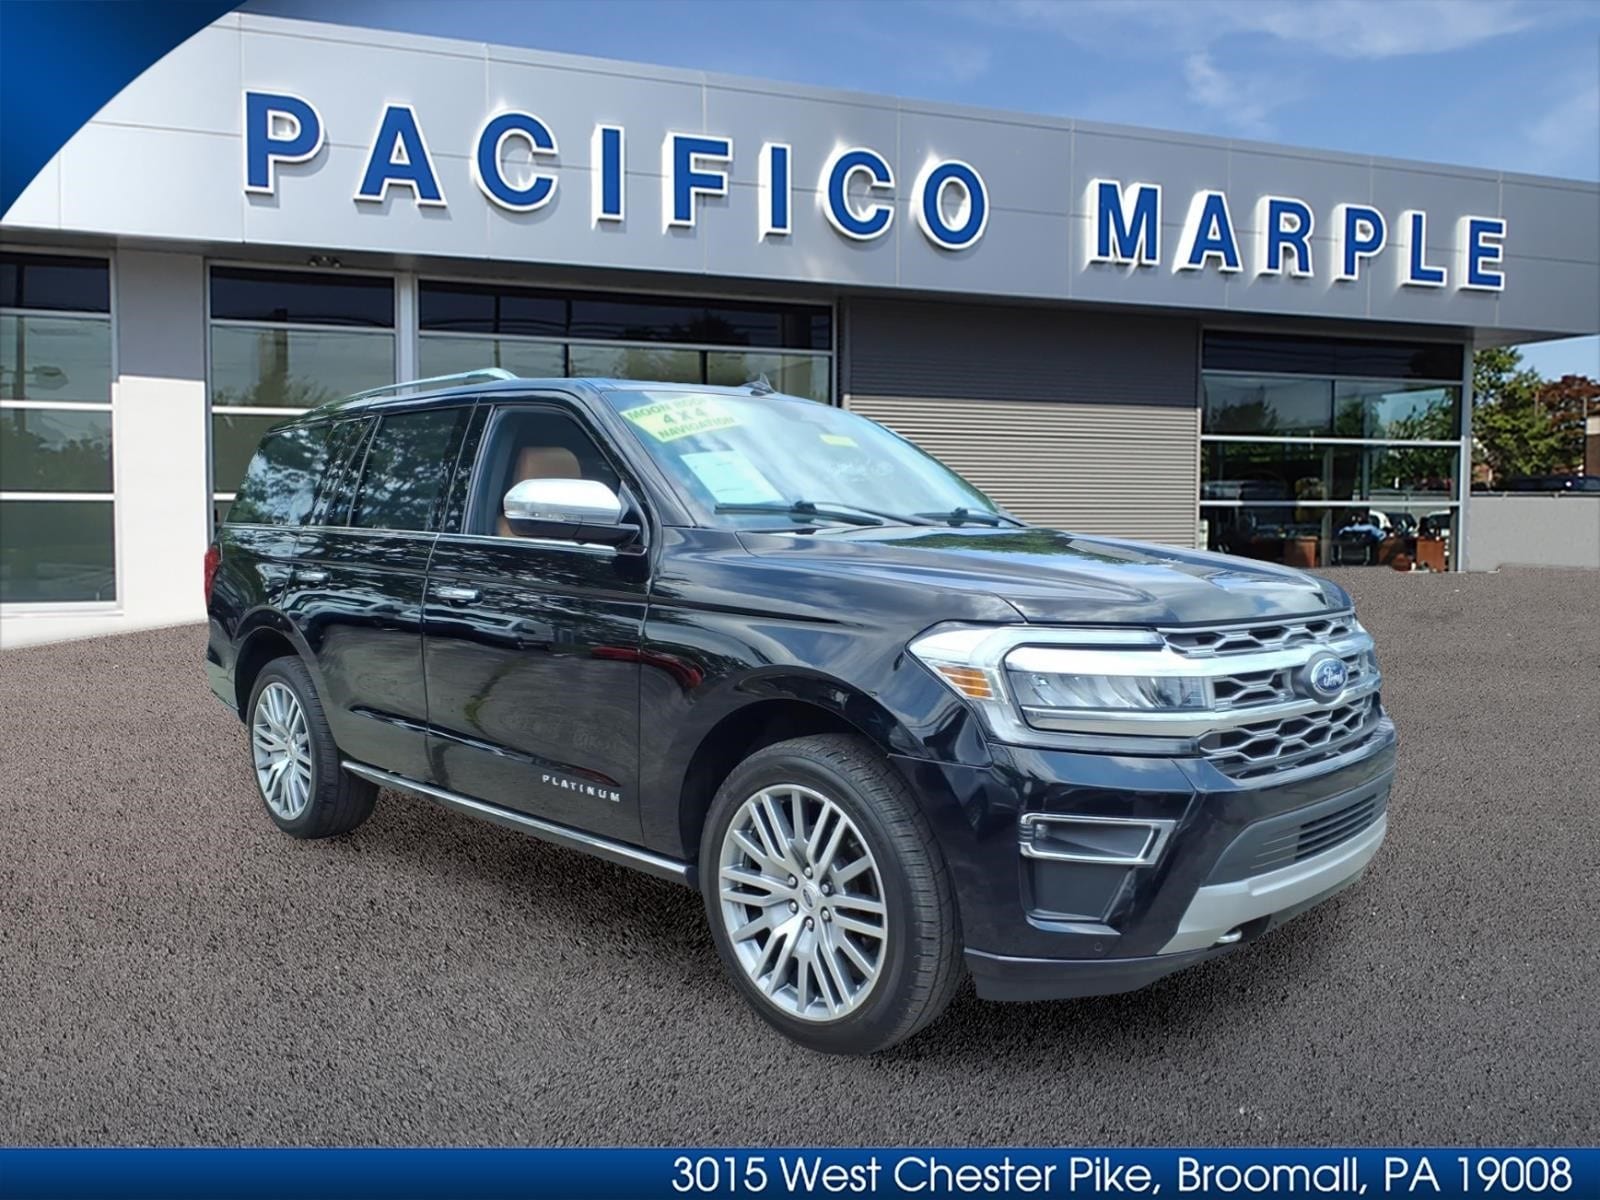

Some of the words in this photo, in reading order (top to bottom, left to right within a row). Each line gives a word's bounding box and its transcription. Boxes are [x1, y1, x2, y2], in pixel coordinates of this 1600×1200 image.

[243, 89, 990, 249] PACIFICO
[1086, 179, 1507, 292] MARPLE
[626, 401, 672, 420] MOON
[541, 774, 621, 803] PLATINUM
